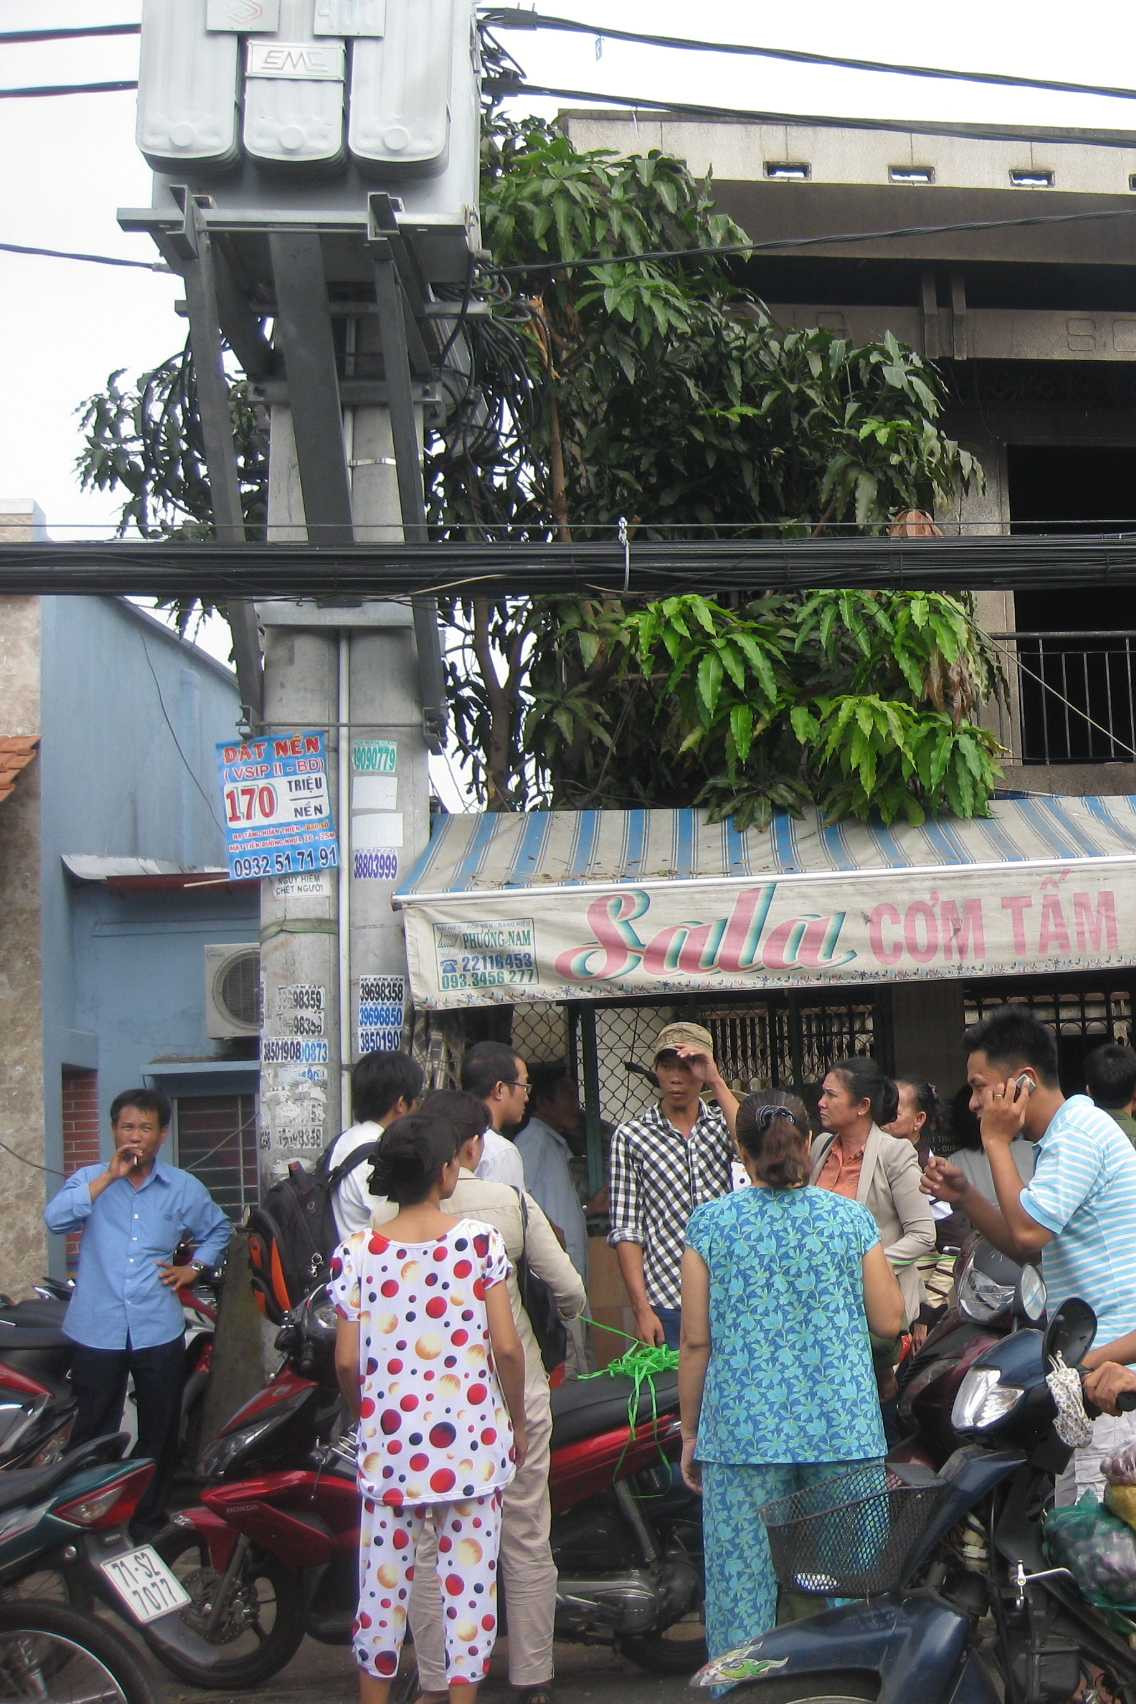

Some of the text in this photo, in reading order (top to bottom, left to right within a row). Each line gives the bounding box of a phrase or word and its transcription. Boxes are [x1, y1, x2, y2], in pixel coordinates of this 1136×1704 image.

[287, 777, 323, 793] TRIỆU
[226, 785, 277, 823] 170
[234, 847, 337, 878] 0932 51 71 91
[554, 882, 858, 981] Sala
[868, 889, 986, 966] CƠM
[1001, 868, 1119, 957] TẤM
[441, 969, 535, 989] 093.3456 277
[360, 1030, 403, 1052] 3850190
[112, 1552, 161, 1588] 71-S2
[132, 1578, 178, 1616] 7077
